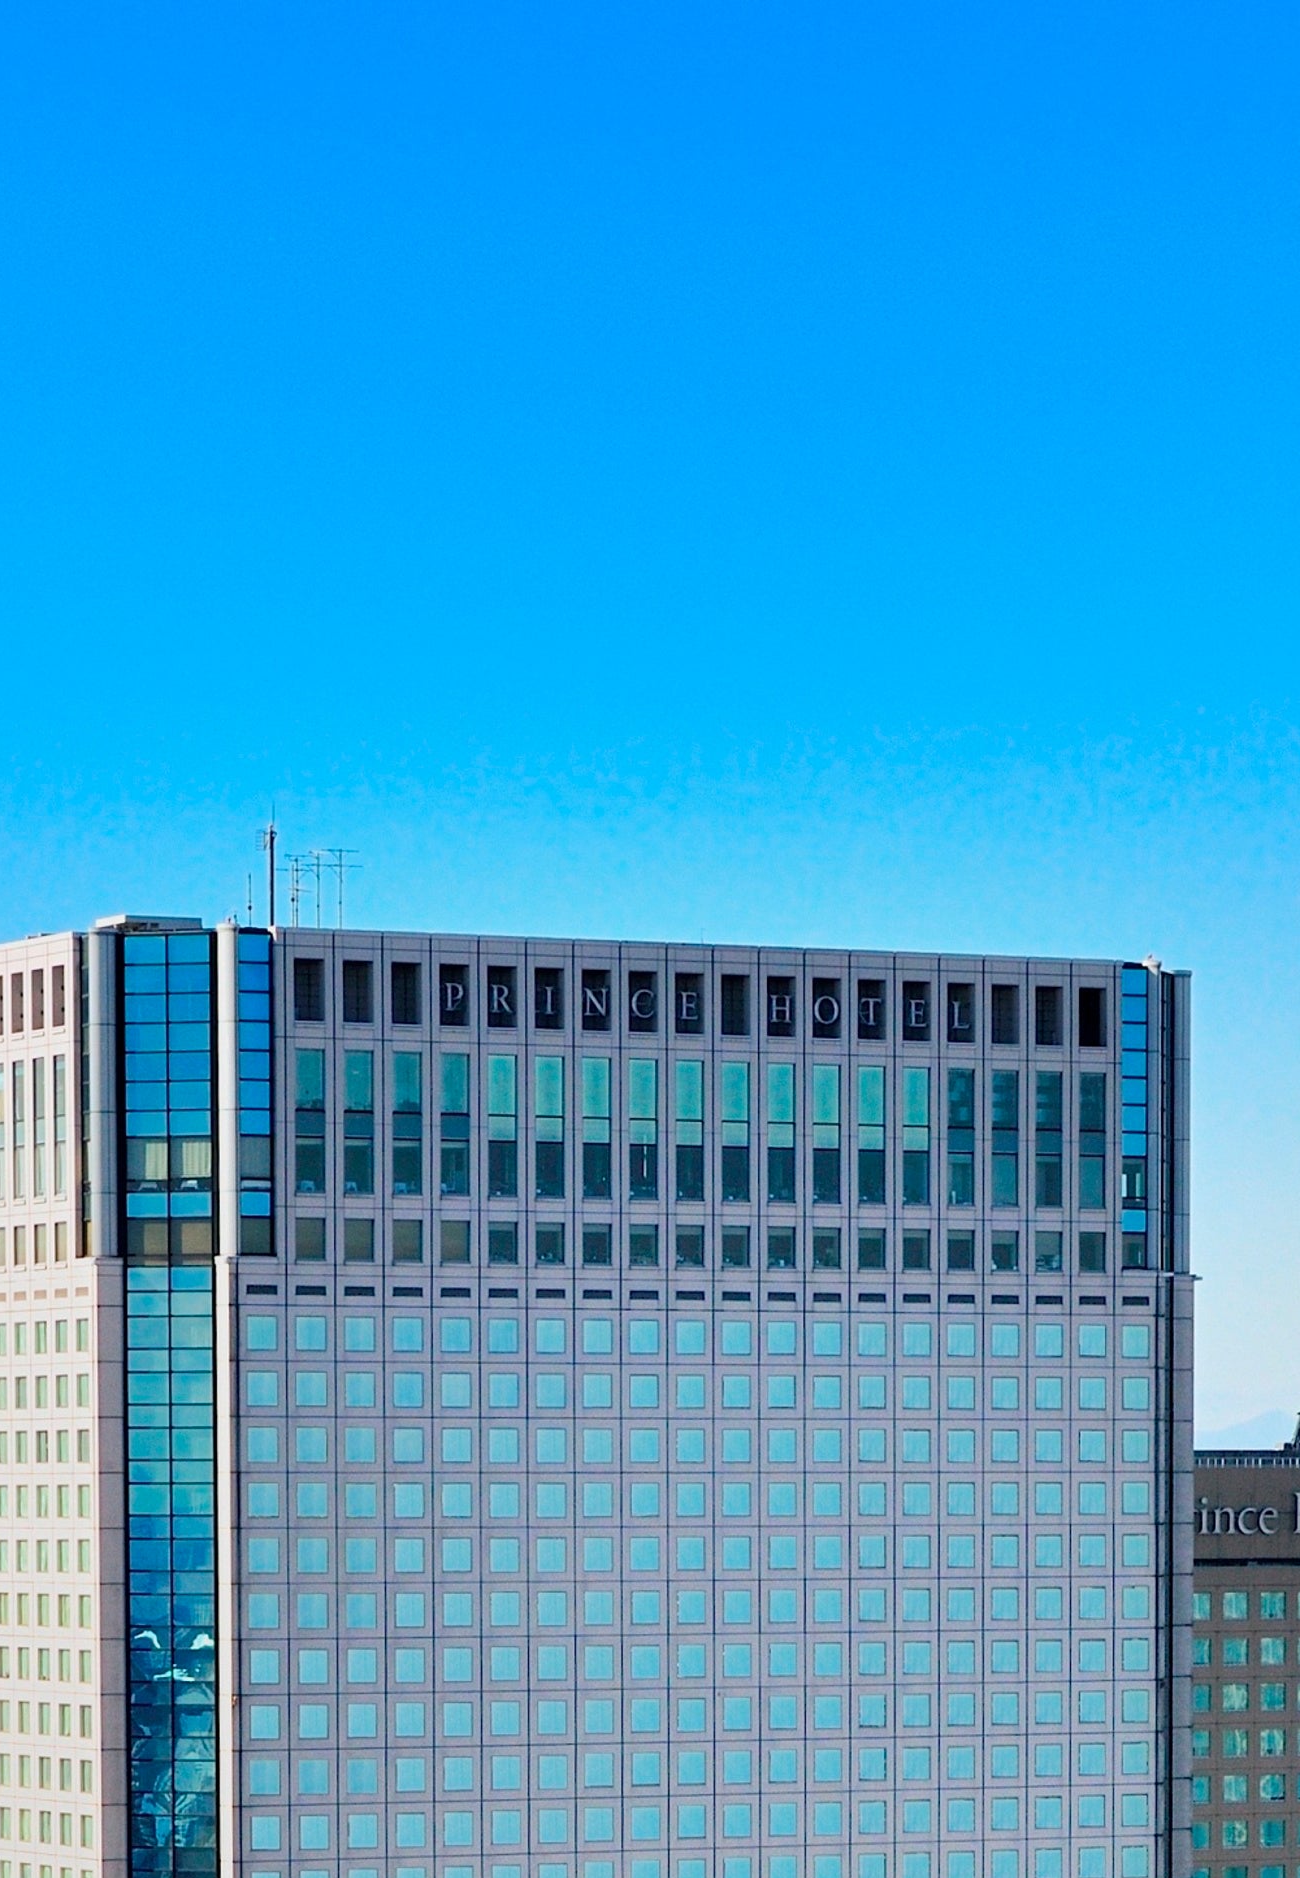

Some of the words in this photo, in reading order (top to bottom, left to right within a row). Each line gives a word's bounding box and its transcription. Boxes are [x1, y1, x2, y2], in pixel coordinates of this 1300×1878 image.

[444, 981, 699, 1021] PRINCE
[769, 993, 971, 1031] HOTEL
[1194, 1497, 1279, 1536] ince
